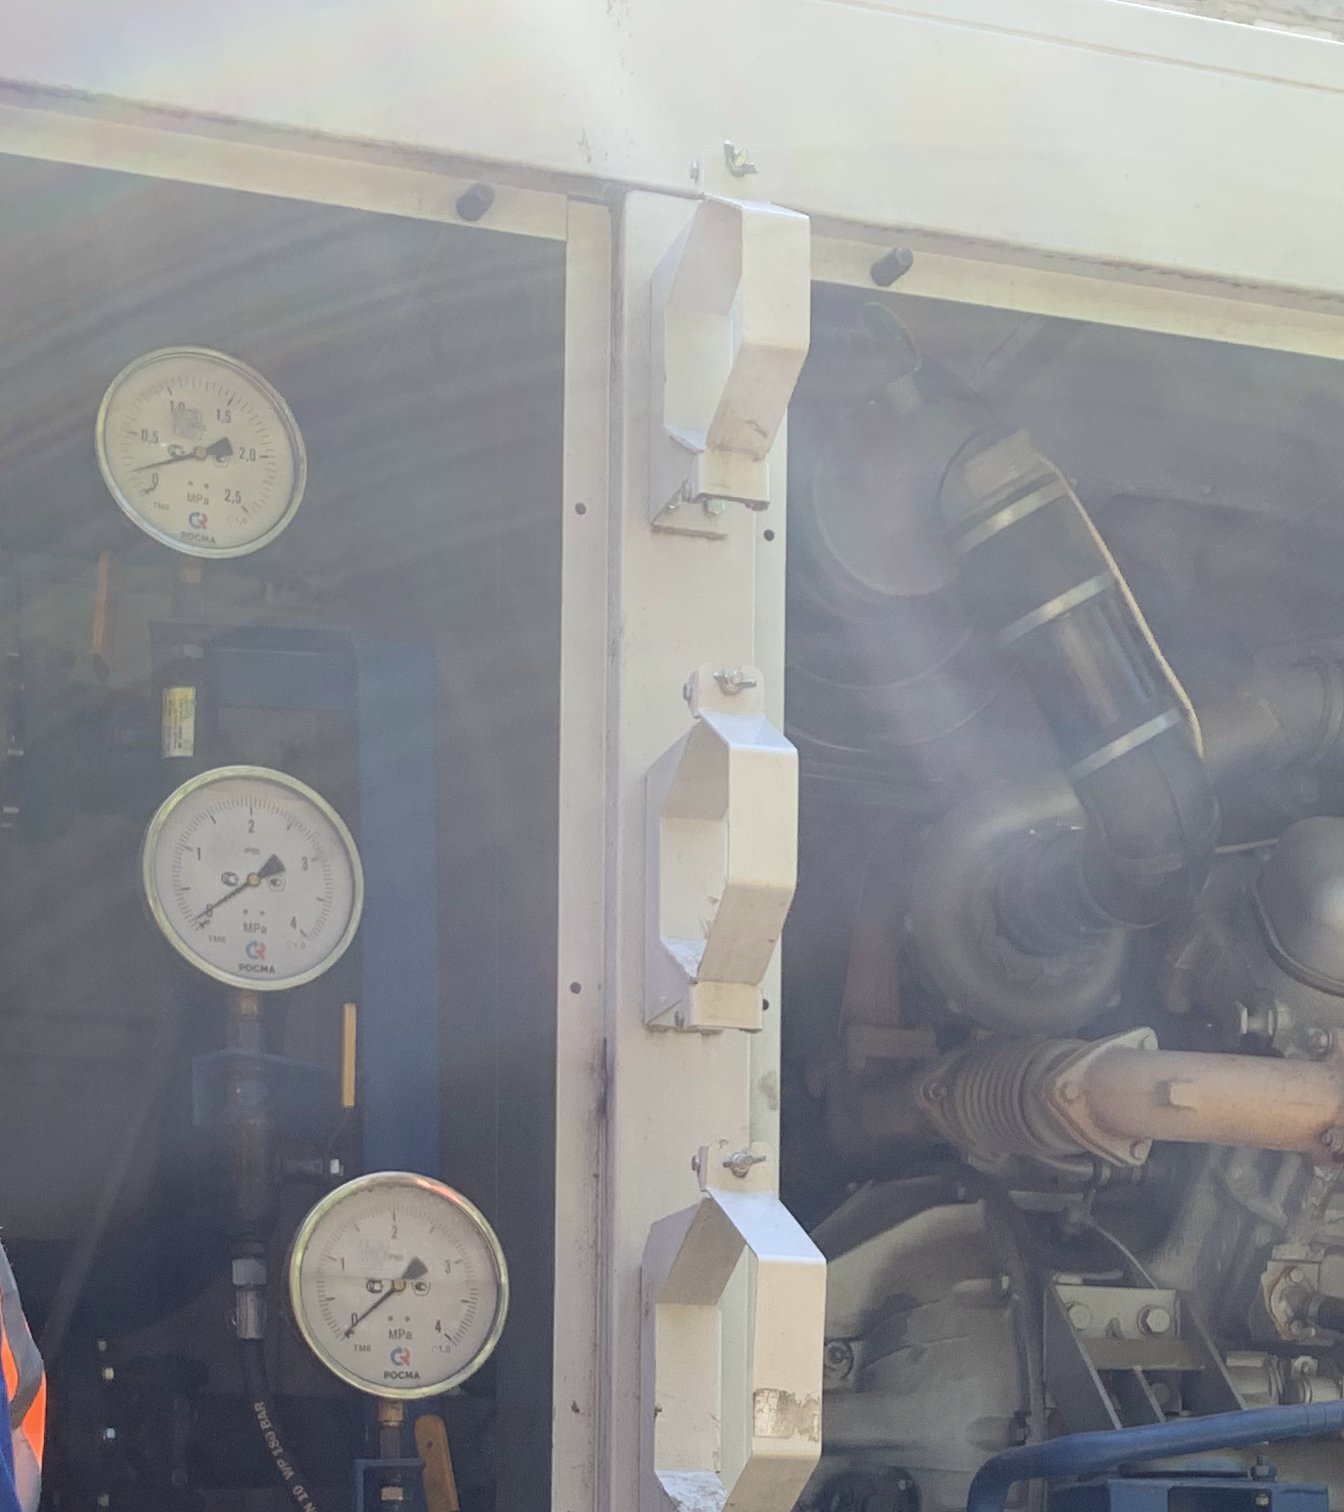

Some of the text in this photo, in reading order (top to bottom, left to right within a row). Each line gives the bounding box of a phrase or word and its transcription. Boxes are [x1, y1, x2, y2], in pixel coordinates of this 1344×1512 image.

[217, 408, 232, 424] 1,5
[141, 428, 159, 444] 0,5
[239, 446, 256, 463] 2,0
[224, 489, 242, 504] 2,5
[247, 819, 255, 834] 2
[301, 857, 309, 871] 3
[290, 916, 297, 930] 4
[391, 1225, 398, 1240] 2
[444, 1260, 451, 1274] 3
[388, 1329, 412, 1340] MPa
[434, 1320, 442, 1334] 4
[383, 1371, 420, 1380] РОСМА
[254, 1401, 272, 1430] BAR
[265, 1431, 284, 1457] 180
